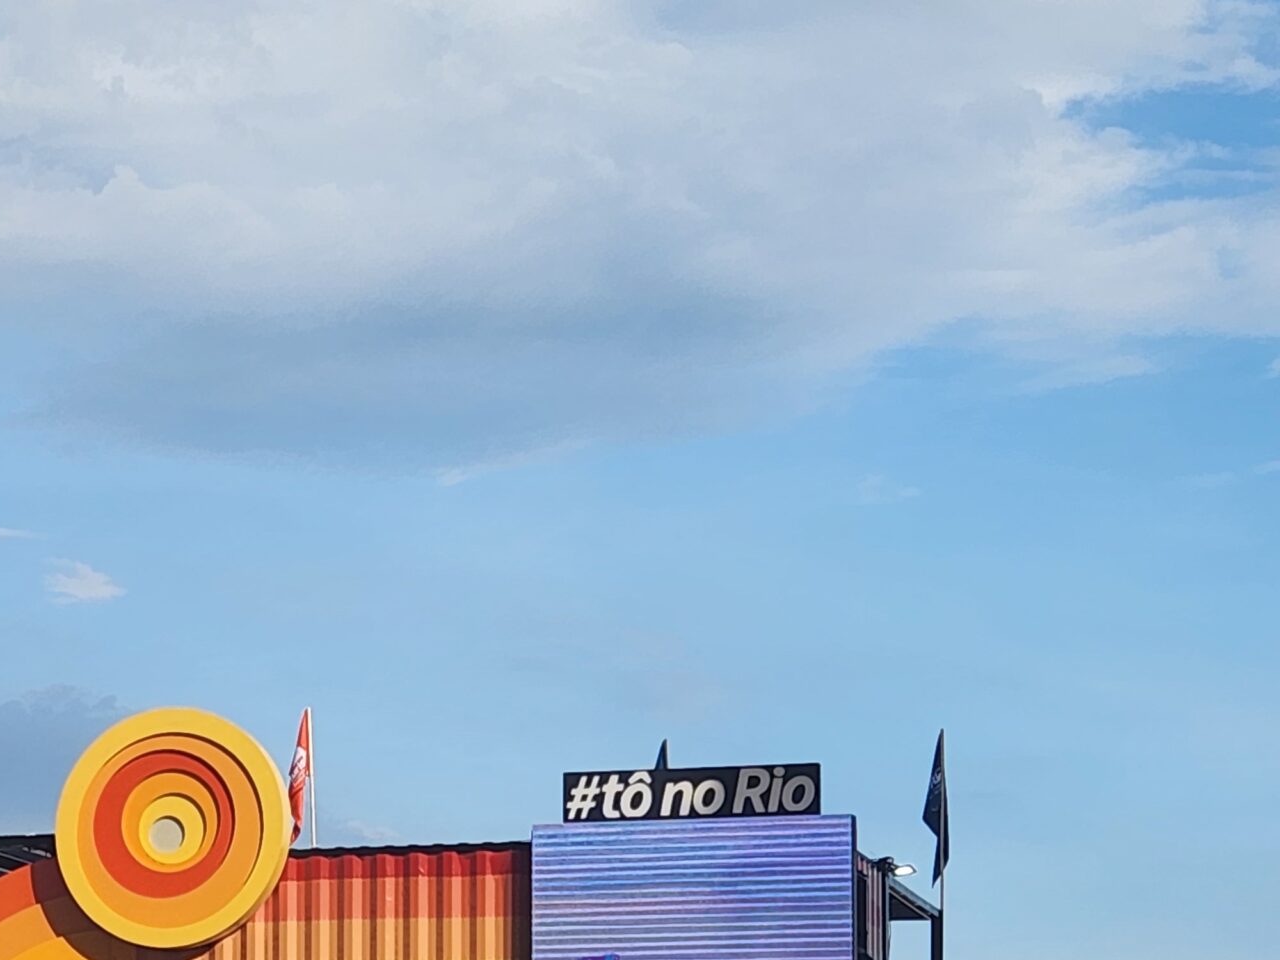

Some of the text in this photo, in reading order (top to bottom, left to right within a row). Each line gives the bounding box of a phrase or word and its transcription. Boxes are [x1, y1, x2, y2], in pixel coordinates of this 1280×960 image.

[566, 767, 816, 820] #tô no Rio
